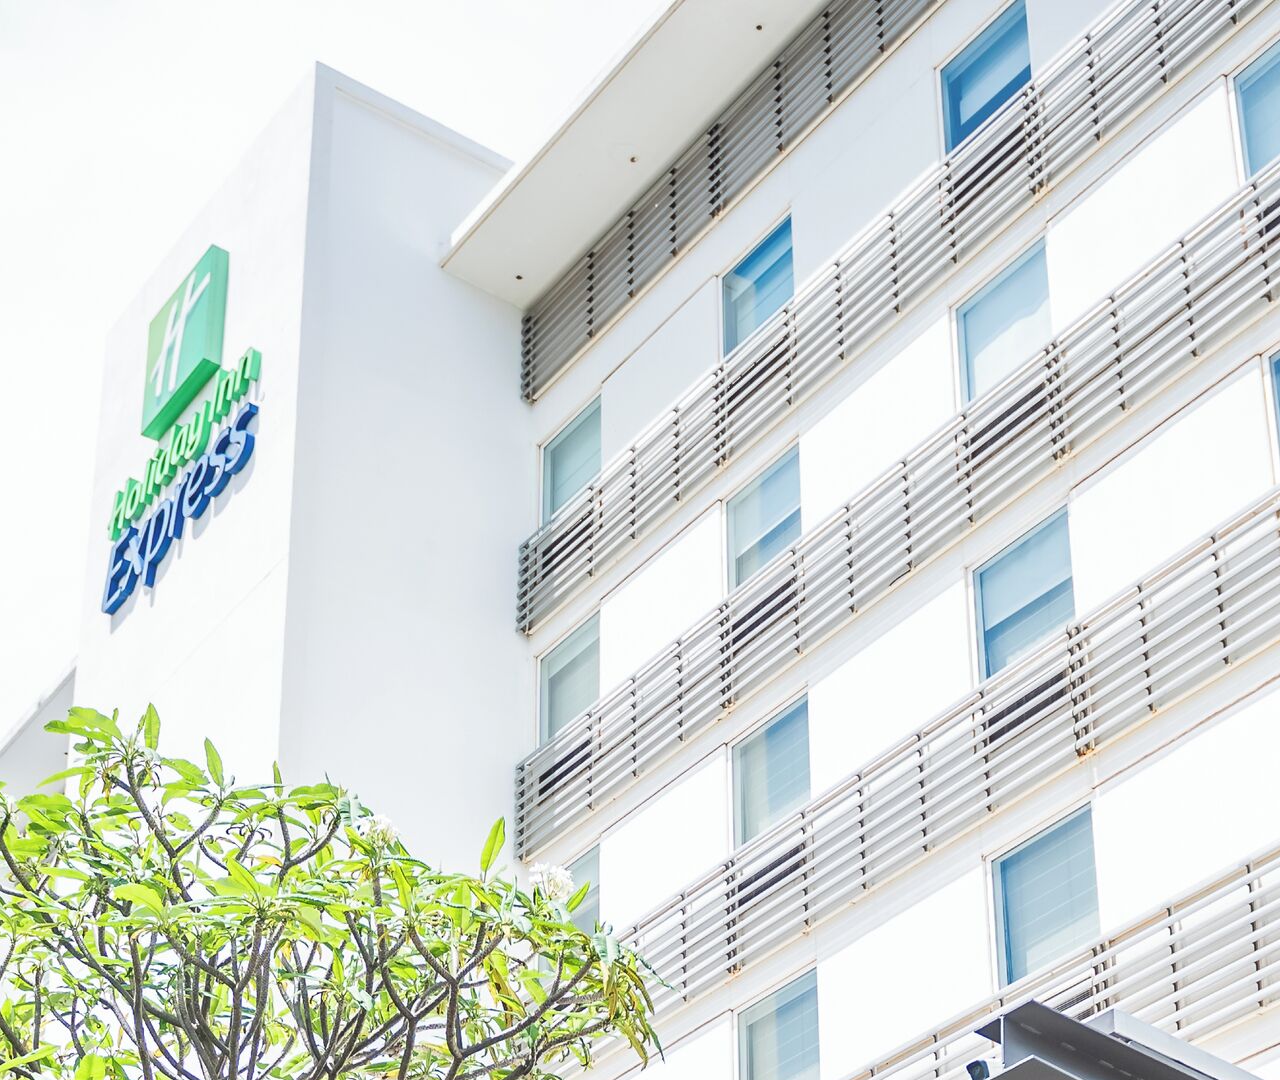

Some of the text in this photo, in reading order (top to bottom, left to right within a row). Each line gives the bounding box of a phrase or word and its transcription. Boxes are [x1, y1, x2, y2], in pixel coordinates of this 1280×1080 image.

[102, 402, 259, 615] Express
[108, 347, 262, 541] Holiday Inn
